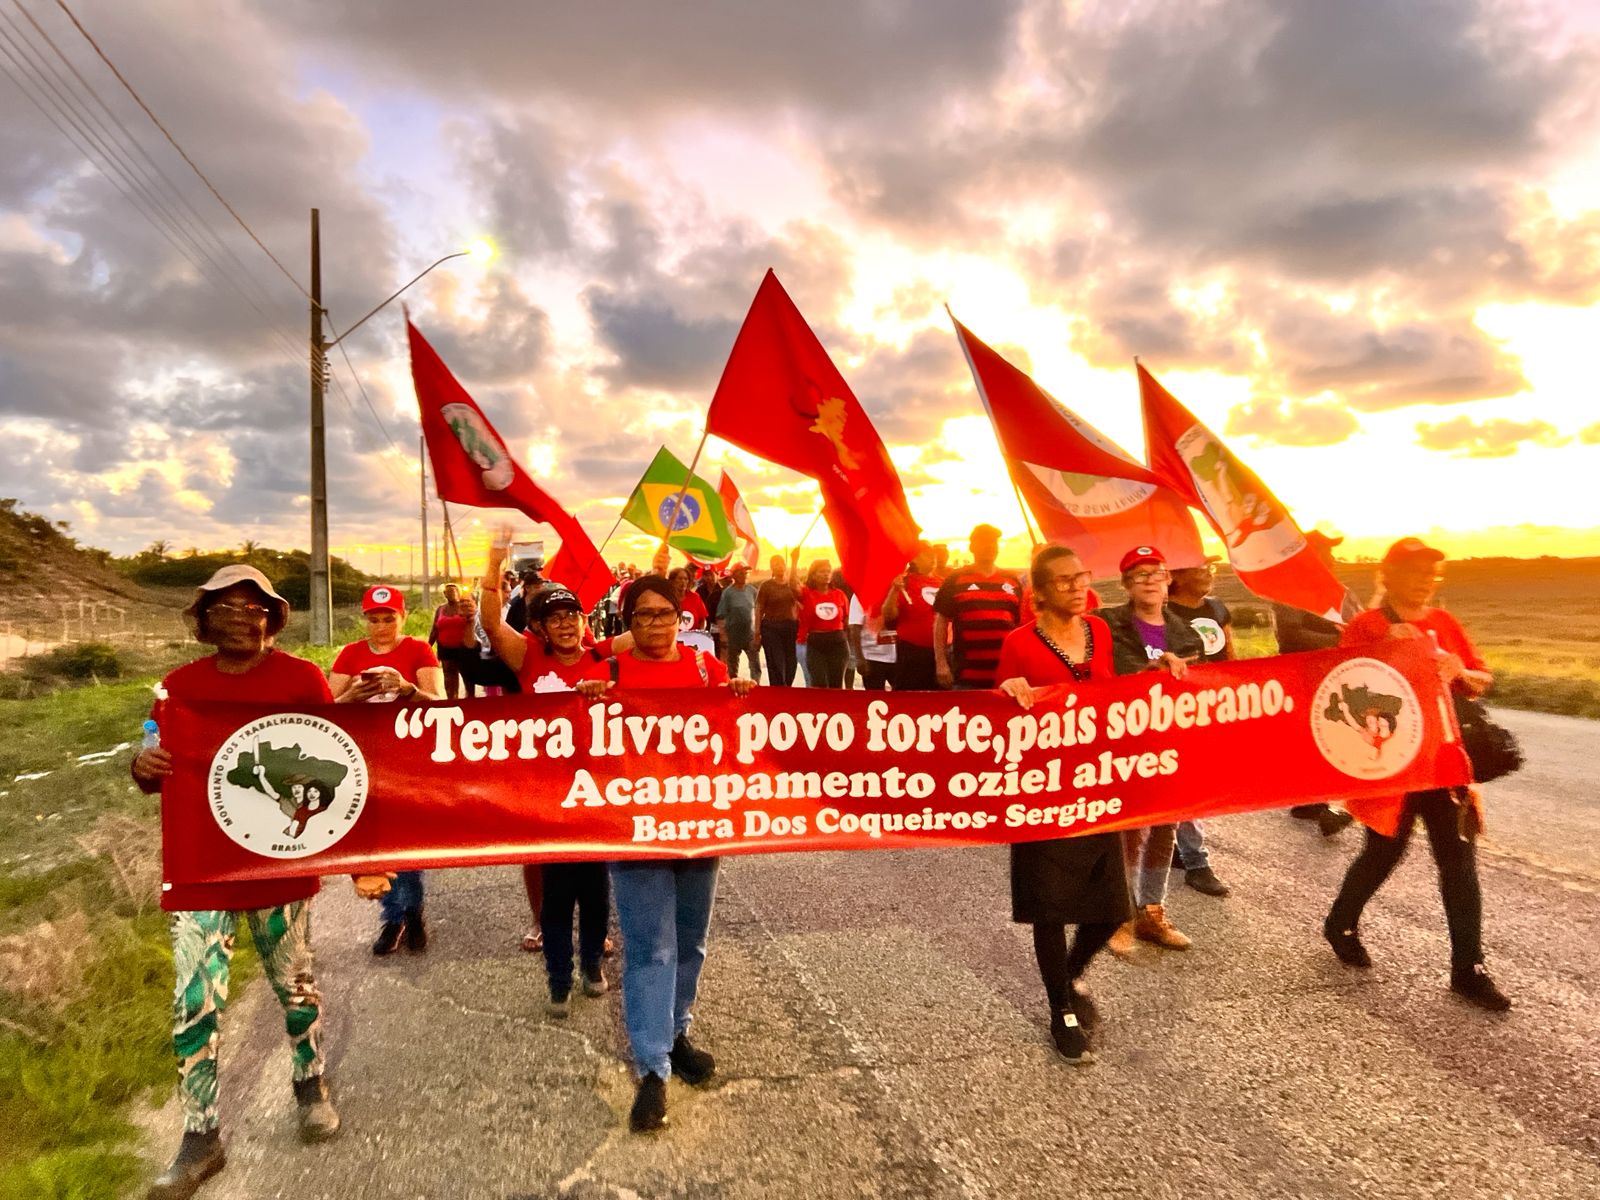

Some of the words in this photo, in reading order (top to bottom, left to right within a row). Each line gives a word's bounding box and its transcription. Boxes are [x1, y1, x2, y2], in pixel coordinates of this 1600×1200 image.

[239, 717, 330, 741] TRABALHADORES
[395, 706, 575, 763] “Terra
[588, 702, 723, 765] livre,
[736, 712, 855, 765] povo
[1106, 679, 1293, 740] soberano.
[221, 742, 239, 761] DOS
[331, 731, 358, 764] RURAIS
[353, 767, 363, 788] SEM
[561, 767, 936, 810] Acampamento
[948, 759, 1062, 798] oziel
[1073, 749, 1179, 789] alves
[213, 764, 233, 827] MOVIMENTO
[344, 792, 361, 821] TERRA
[632, 813, 735, 843] Barra
[744, 810, 808, 838] Dos
[816, 807, 998, 839] Coqueiros-
[1005, 797, 1122, 828] Sergipe
[271, 843, 307, 852] BRASIL
